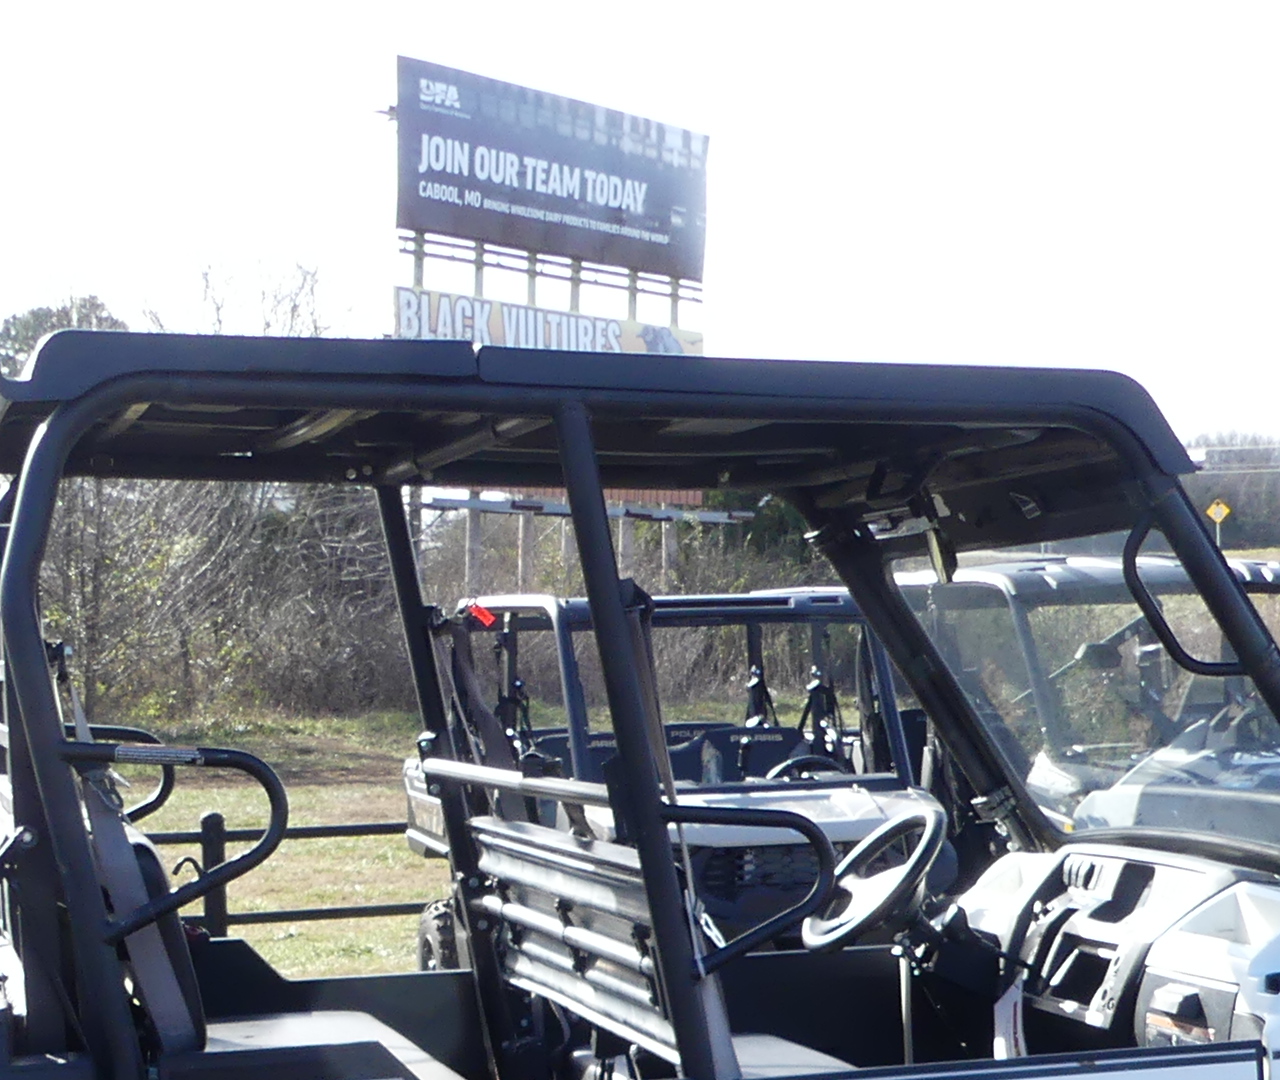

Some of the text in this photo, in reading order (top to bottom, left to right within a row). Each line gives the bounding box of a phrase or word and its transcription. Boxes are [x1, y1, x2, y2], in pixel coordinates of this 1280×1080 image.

[420, 78, 460, 109] DFA
[418, 134, 647, 214] JOIN OUR TEAM TODAY
[419, 181, 462, 206] CABOOL,
[465, 189, 481, 208] MO
[398, 287, 623, 352] BLACK VULTURES
